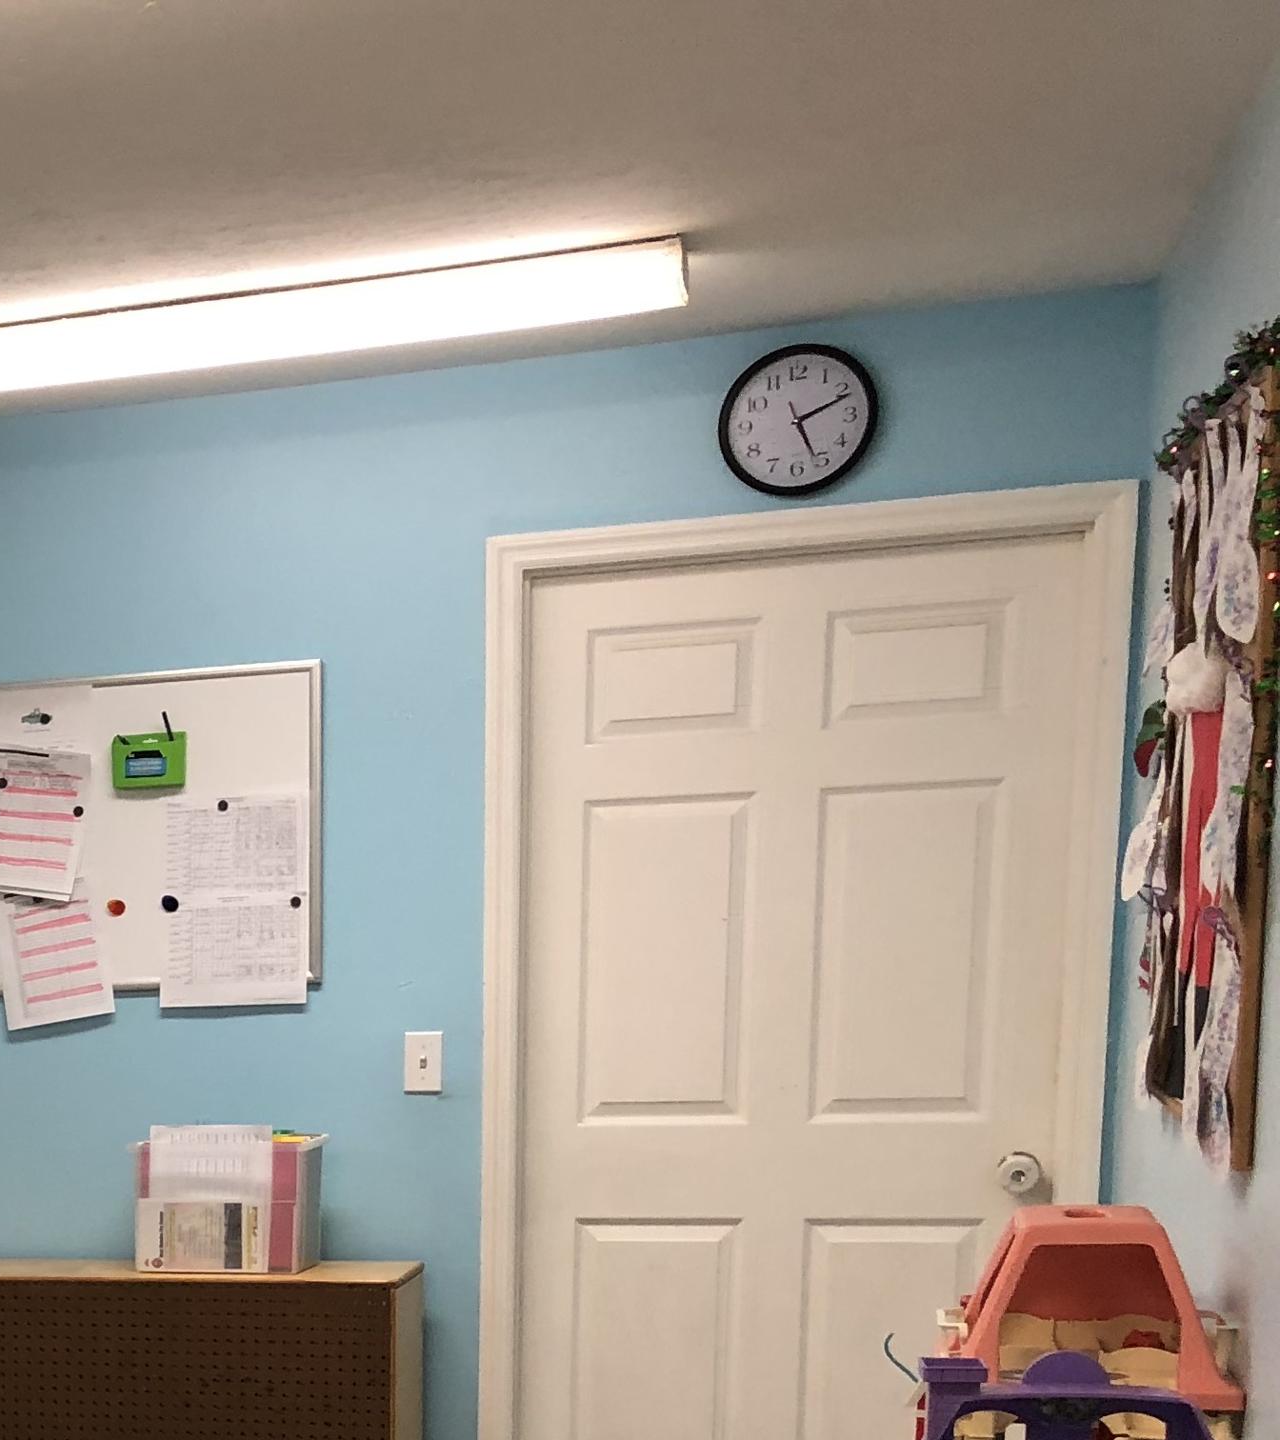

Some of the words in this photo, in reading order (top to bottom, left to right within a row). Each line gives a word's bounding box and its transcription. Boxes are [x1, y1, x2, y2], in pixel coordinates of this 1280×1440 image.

[788, 364, 808, 381] 12
[821, 367, 829, 385] 1
[767, 375, 781, 391] 11
[835, 381, 851, 398] 2
[747, 395, 768, 413] 10
[843, 406, 858, 423] 3
[738, 420, 753, 435] 9
[834, 432, 848, 448] 4
[747, 443, 761, 458] 8
[766, 457, 780, 474] 7
[815, 451, 830, 468] 5
[789, 460, 804, 477] 6
